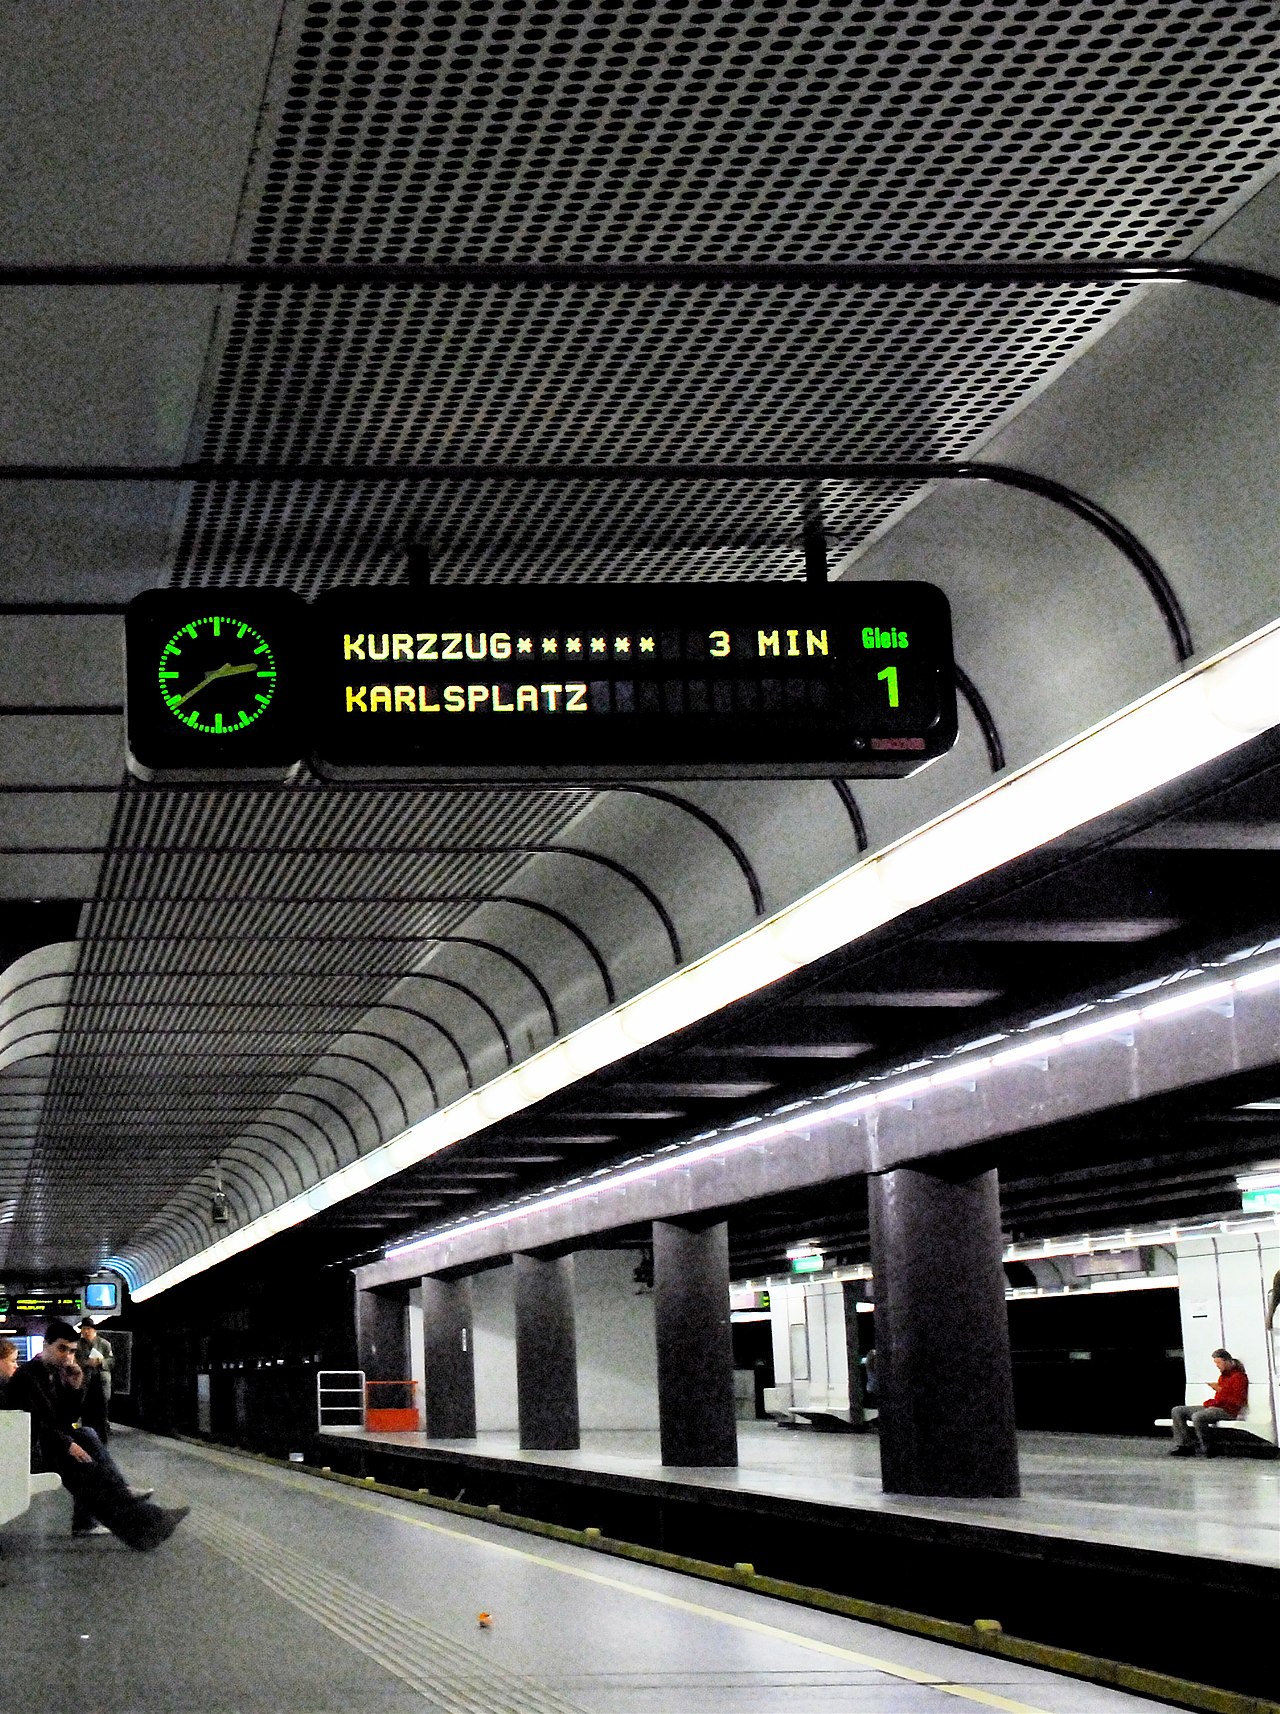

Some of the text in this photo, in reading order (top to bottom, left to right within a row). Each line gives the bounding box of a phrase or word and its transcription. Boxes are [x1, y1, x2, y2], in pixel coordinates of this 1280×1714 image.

[709, 631, 732, 658] 3
[758, 630, 830, 658] MIN
[862, 627, 910, 651] Gleis
[345, 683, 589, 714] KARLSPLATZ
[878, 667, 901, 709] 1
